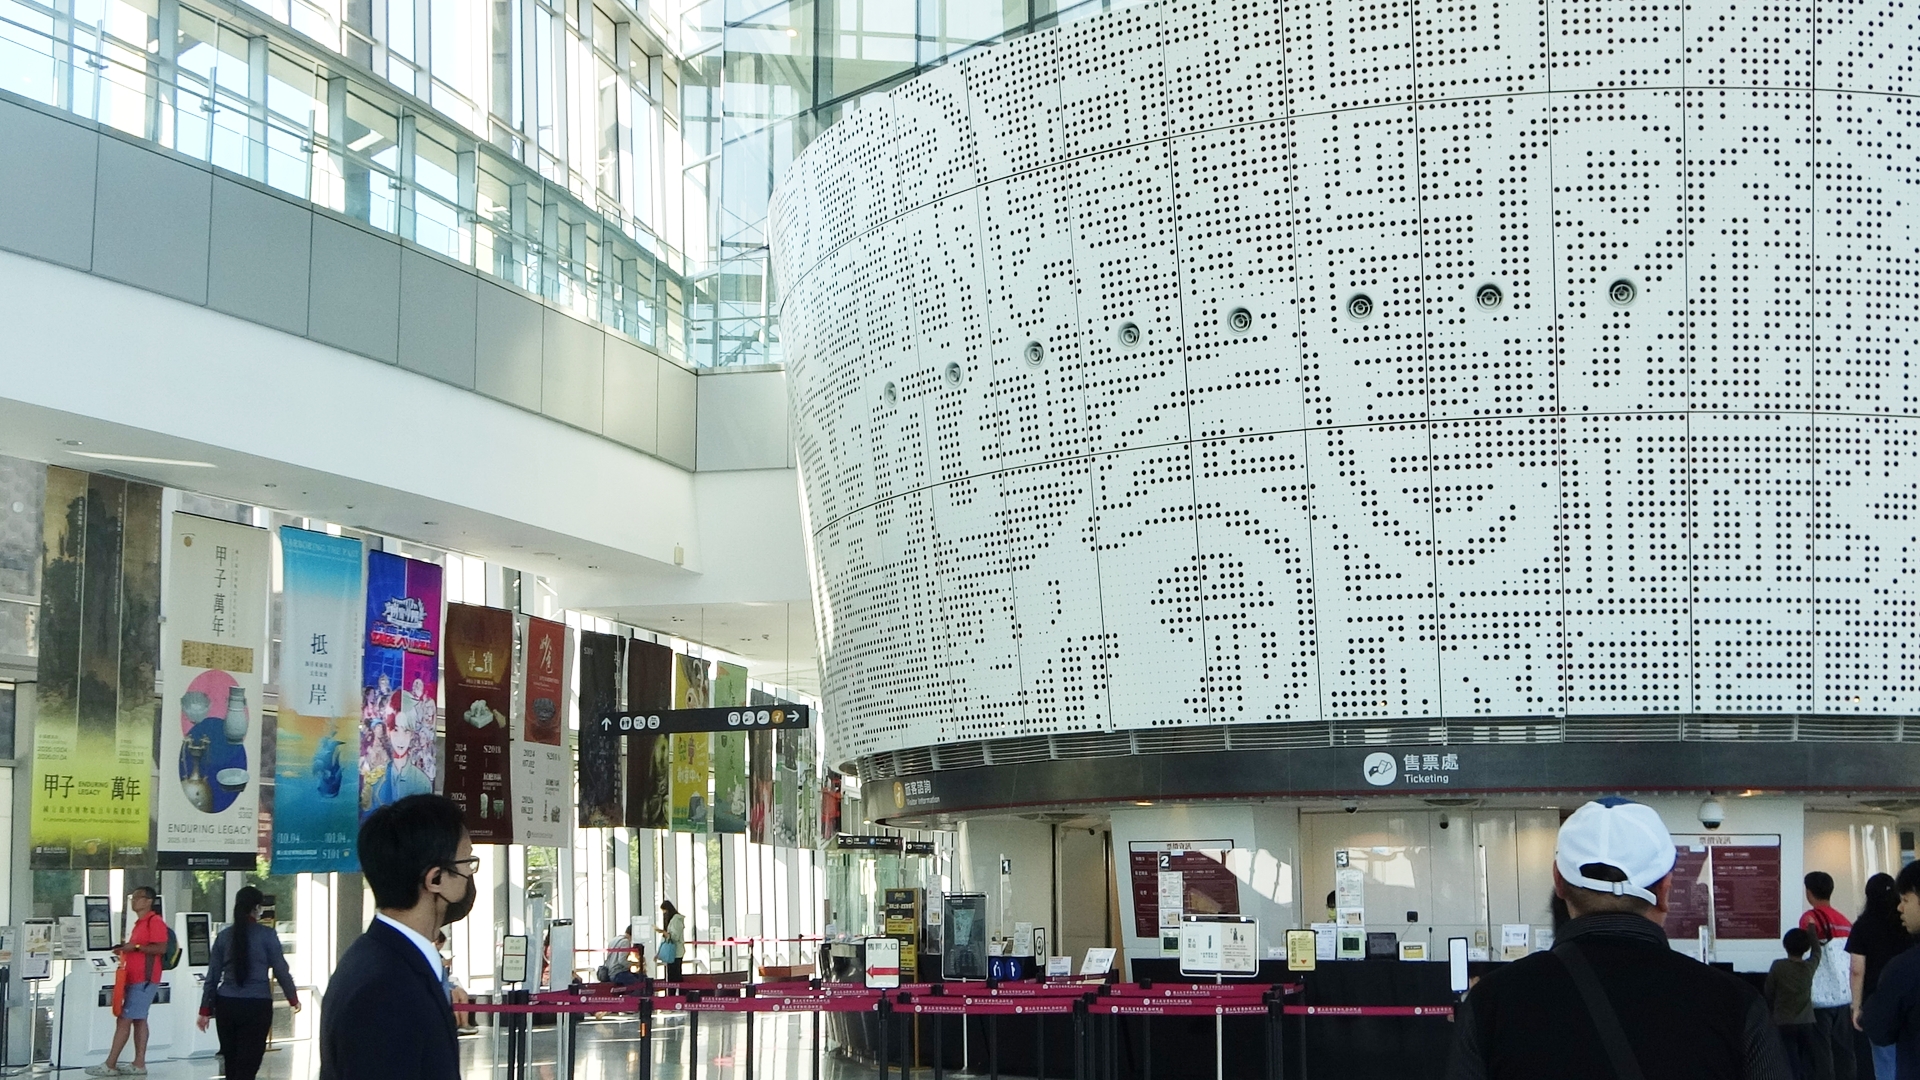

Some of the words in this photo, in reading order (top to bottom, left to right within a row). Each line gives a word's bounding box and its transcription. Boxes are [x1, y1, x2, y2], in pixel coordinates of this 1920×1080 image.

[212, 545, 227, 637] 甲子萬年
[310, 633, 328, 655] 抵
[308, 683, 327, 705] 岸
[1403, 753, 1459, 771] 售票處
[44, 774, 75, 799] 甲子
[1404, 774, 1449, 784] Ticketing
[111, 776, 141, 801] 萬年
[167, 823, 215, 834] ENDURING
[217, 825, 252, 835] LEGACY
[1160, 856, 1170, 867] 2
[1338, 853, 1347, 865] 3
[1003, 861, 1010, 873] 1
[867, 942, 897, 951] 售票入口
